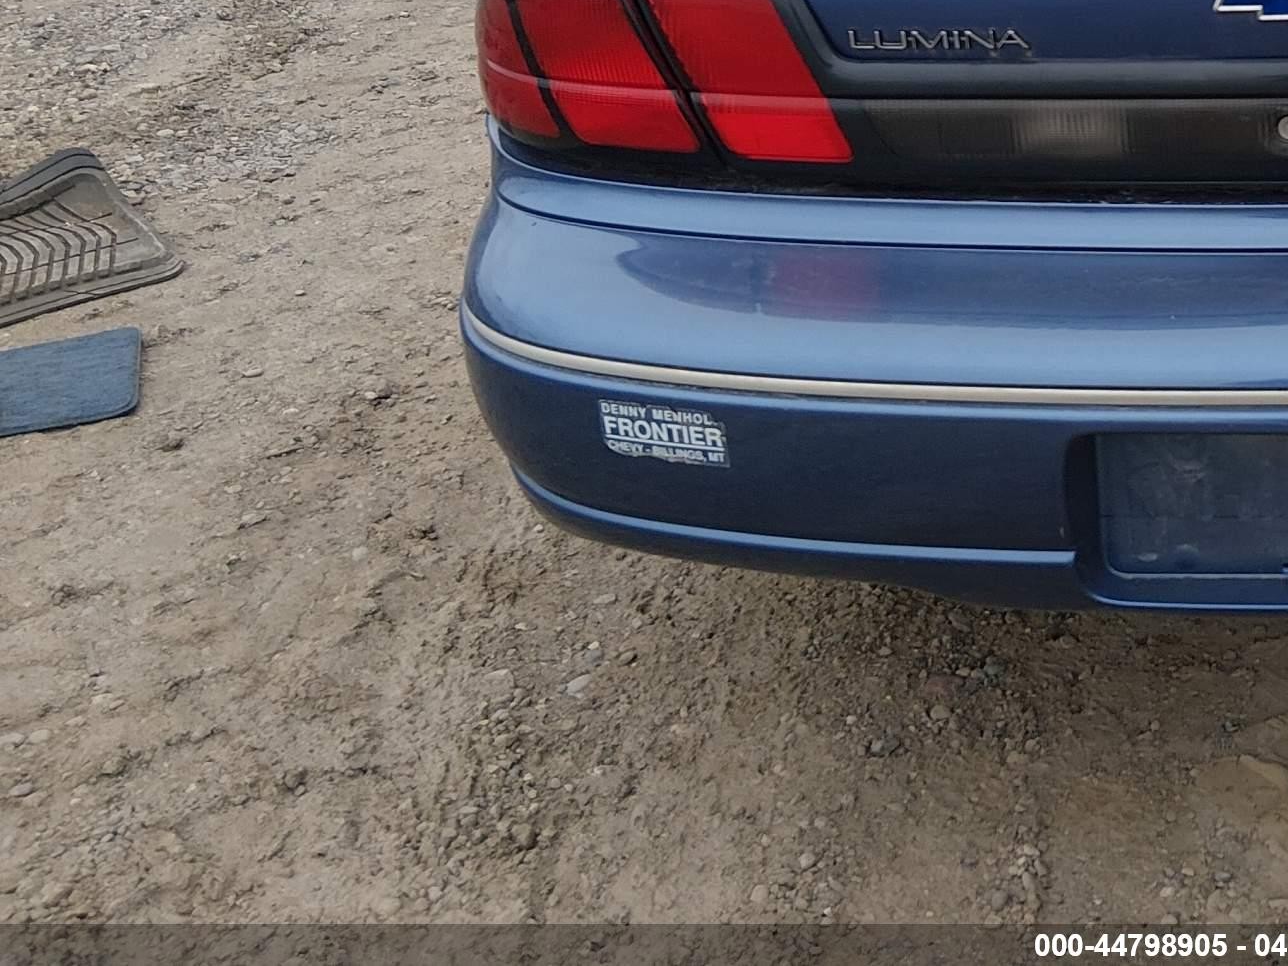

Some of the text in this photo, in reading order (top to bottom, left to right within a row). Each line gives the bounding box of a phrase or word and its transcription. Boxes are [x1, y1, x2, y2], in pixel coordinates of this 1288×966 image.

[848, 29, 1030, 50] LUMINA
[600, 402, 722, 425] DENNY MENHOL
[603, 416, 725, 447] FRONTIER
[708, 452, 725, 463] MT
